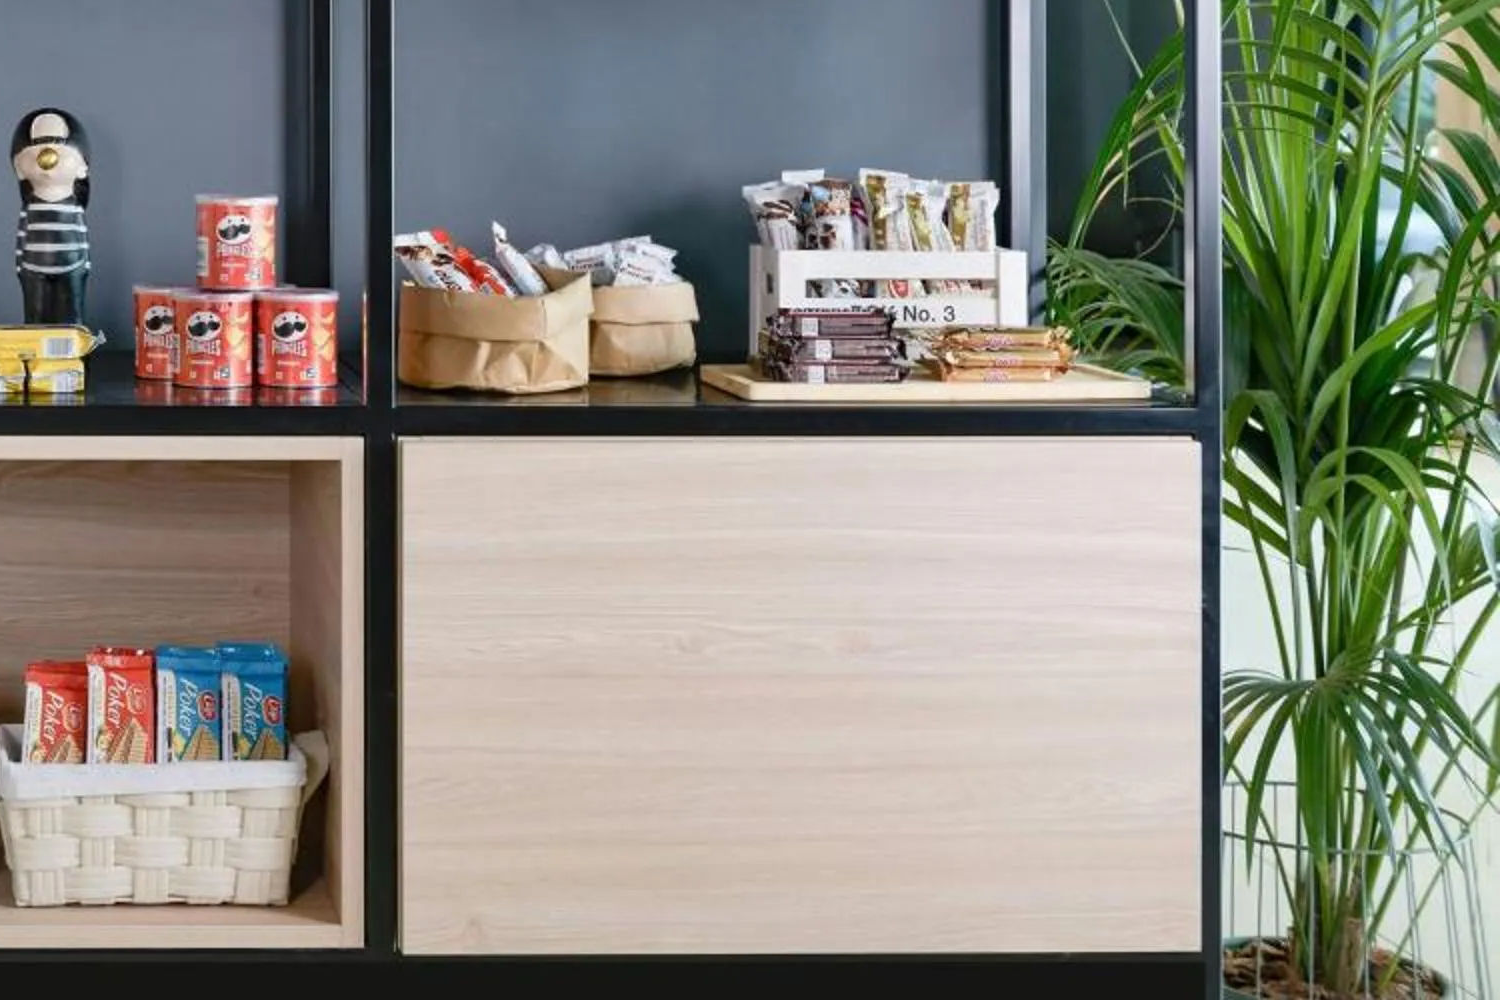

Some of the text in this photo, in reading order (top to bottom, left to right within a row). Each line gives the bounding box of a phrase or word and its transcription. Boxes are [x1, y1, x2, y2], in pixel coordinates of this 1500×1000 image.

[902, 306, 936, 322] No.
[943, 305, 956, 322] 3
[43, 690, 65, 745] Poker
[107, 672, 128, 728] Poker
[180, 677, 199, 737] Poker
[243, 682, 263, 741] Poker
